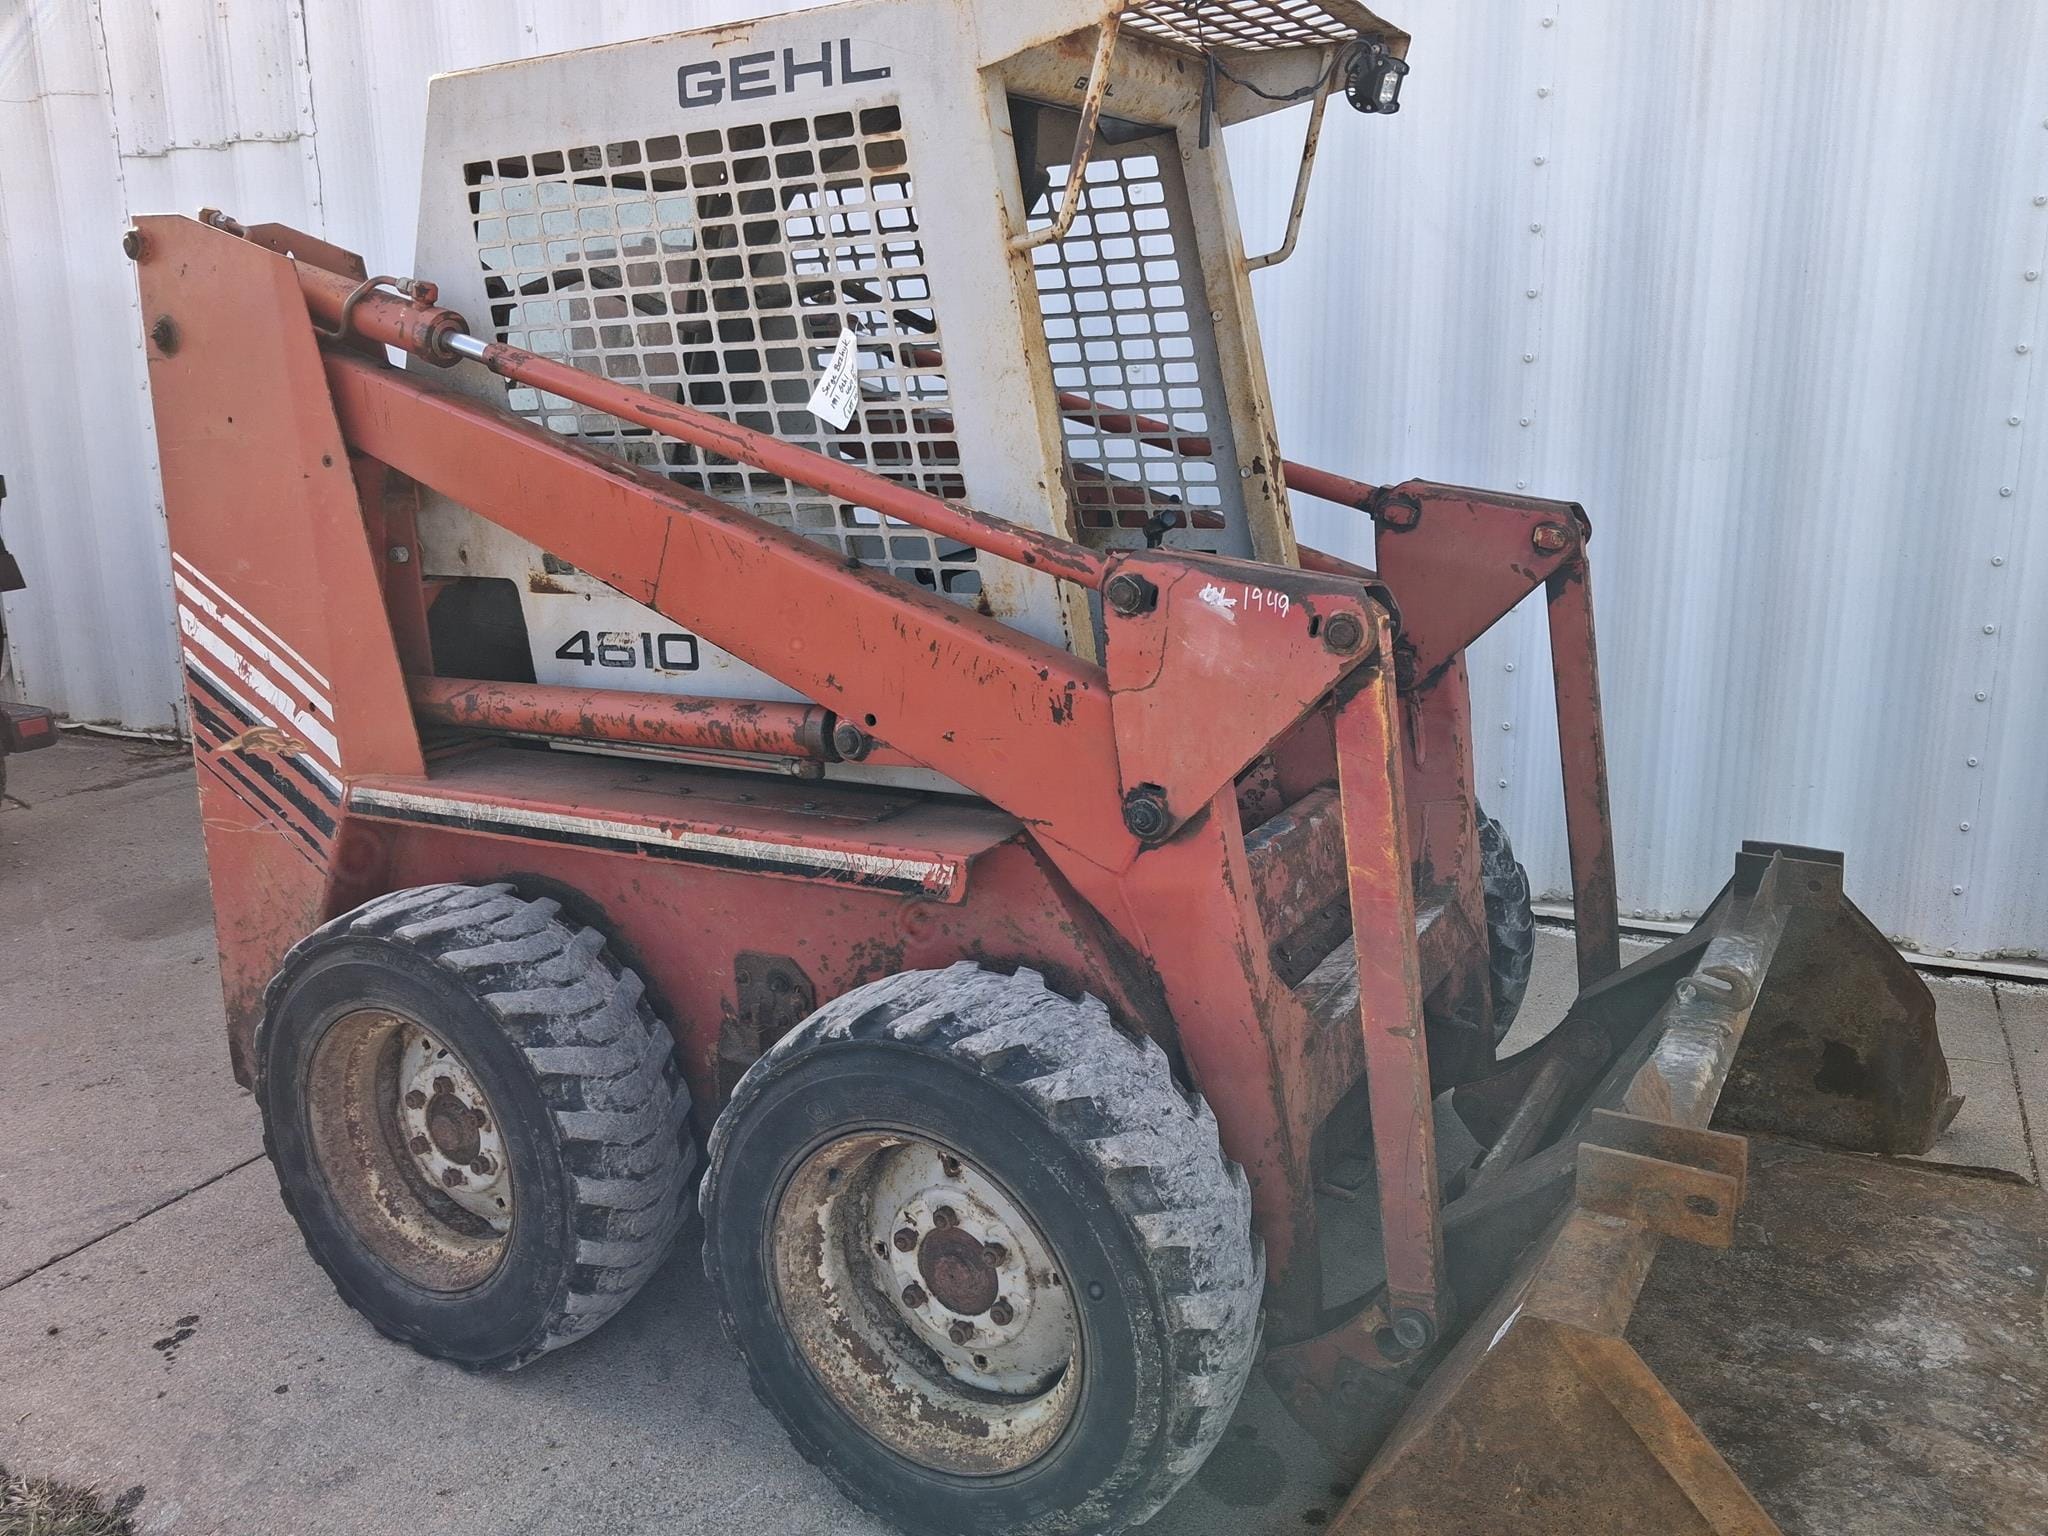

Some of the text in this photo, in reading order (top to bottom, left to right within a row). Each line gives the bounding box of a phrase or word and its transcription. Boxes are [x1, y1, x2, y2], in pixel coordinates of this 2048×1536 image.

[678, 38, 891, 109] GEHL
[1074, 76, 1114, 97] GL
[1244, 586, 1290, 618] 1949
[556, 630, 700, 671] 4610
